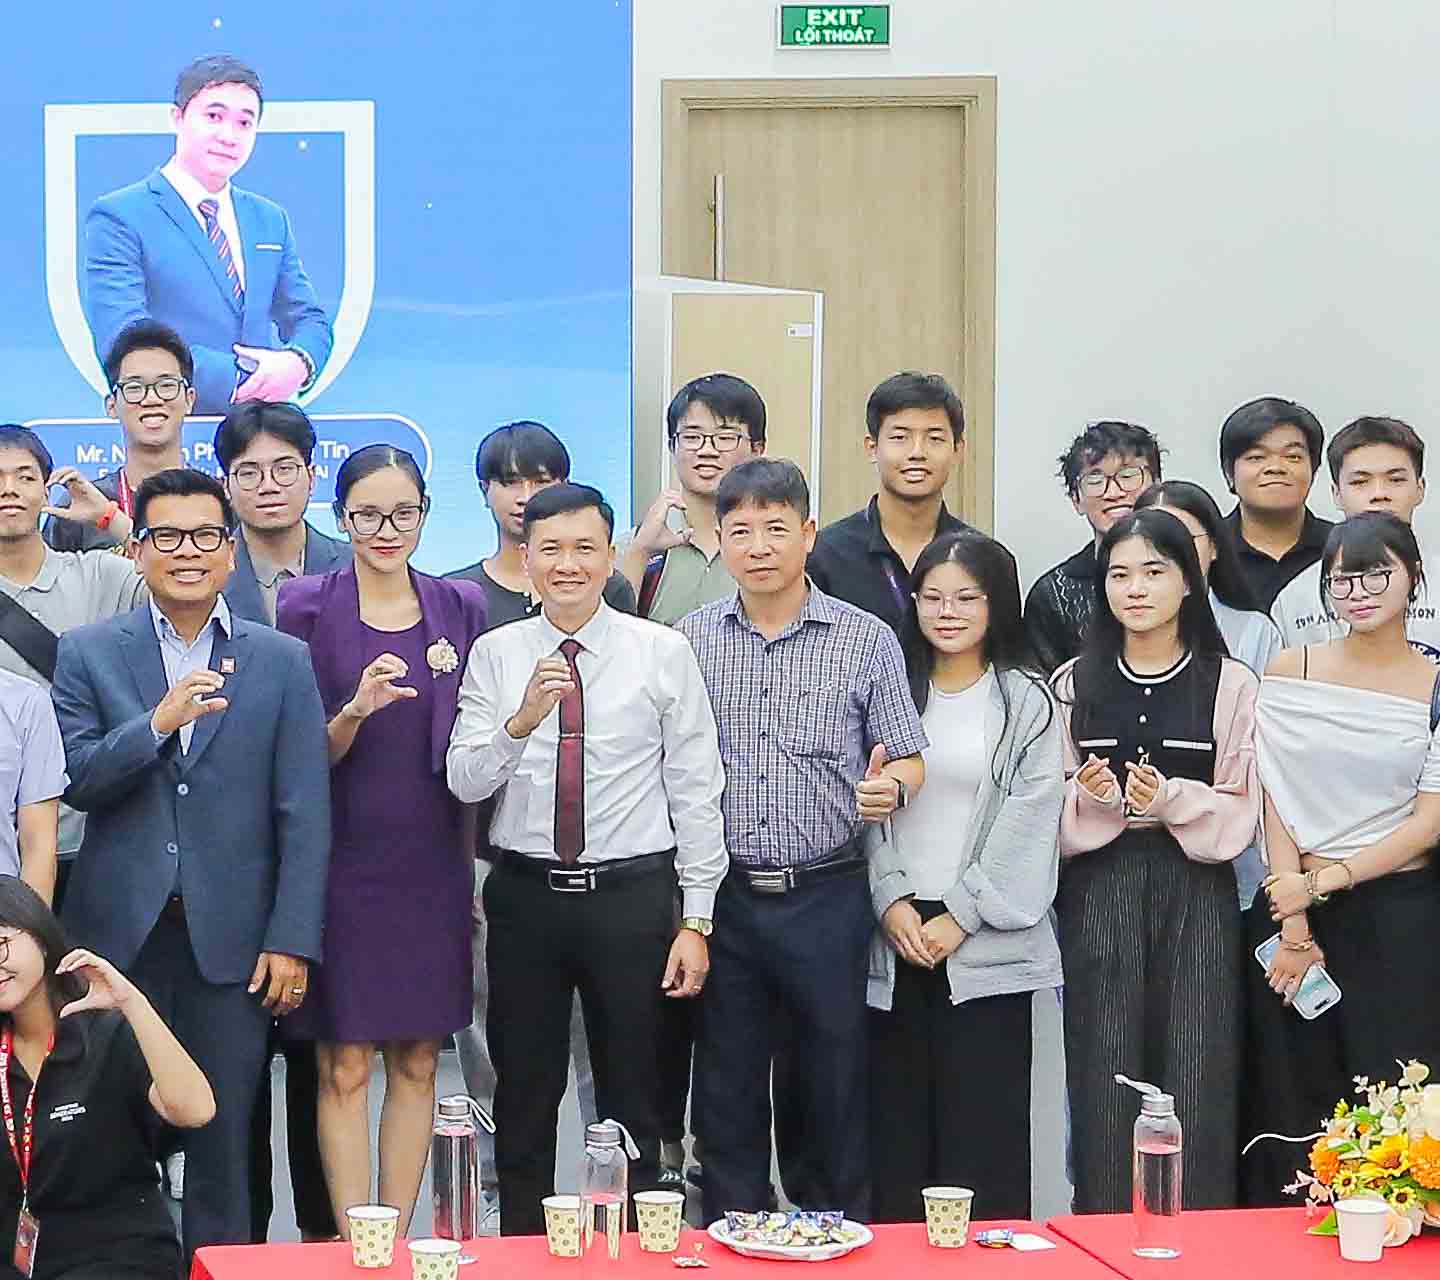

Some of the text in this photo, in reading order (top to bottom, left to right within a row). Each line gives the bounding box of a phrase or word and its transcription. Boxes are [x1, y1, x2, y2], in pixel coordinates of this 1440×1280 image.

[806, 8, 864, 26] EXIT
[822, 25, 875, 43] THOÁT
[76, 442, 108, 465] Mr.
